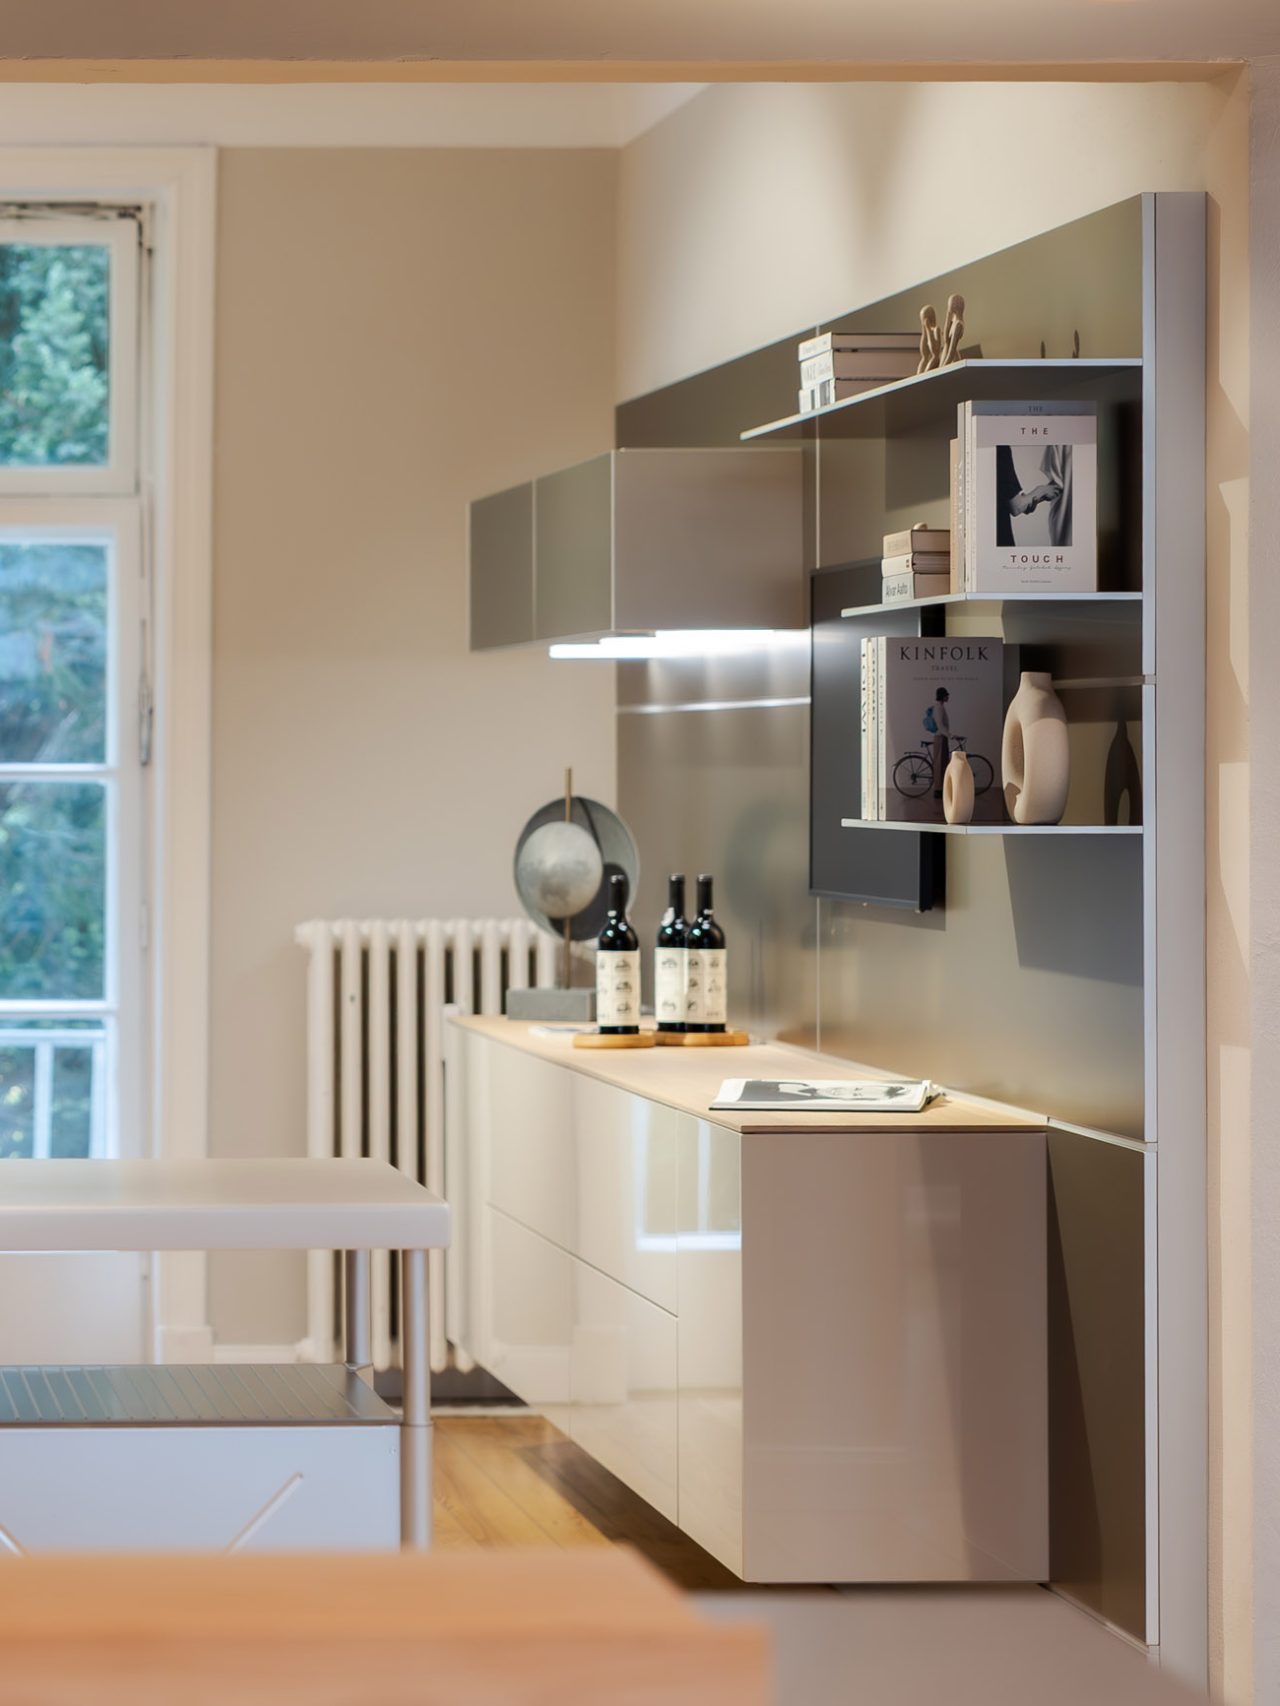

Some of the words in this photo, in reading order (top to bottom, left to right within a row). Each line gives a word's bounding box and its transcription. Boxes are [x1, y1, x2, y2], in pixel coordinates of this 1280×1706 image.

[1020, 427, 1049, 436] THE
[1010, 554, 1065, 564] TOUCH
[900, 647, 989, 661] KINFOLK
